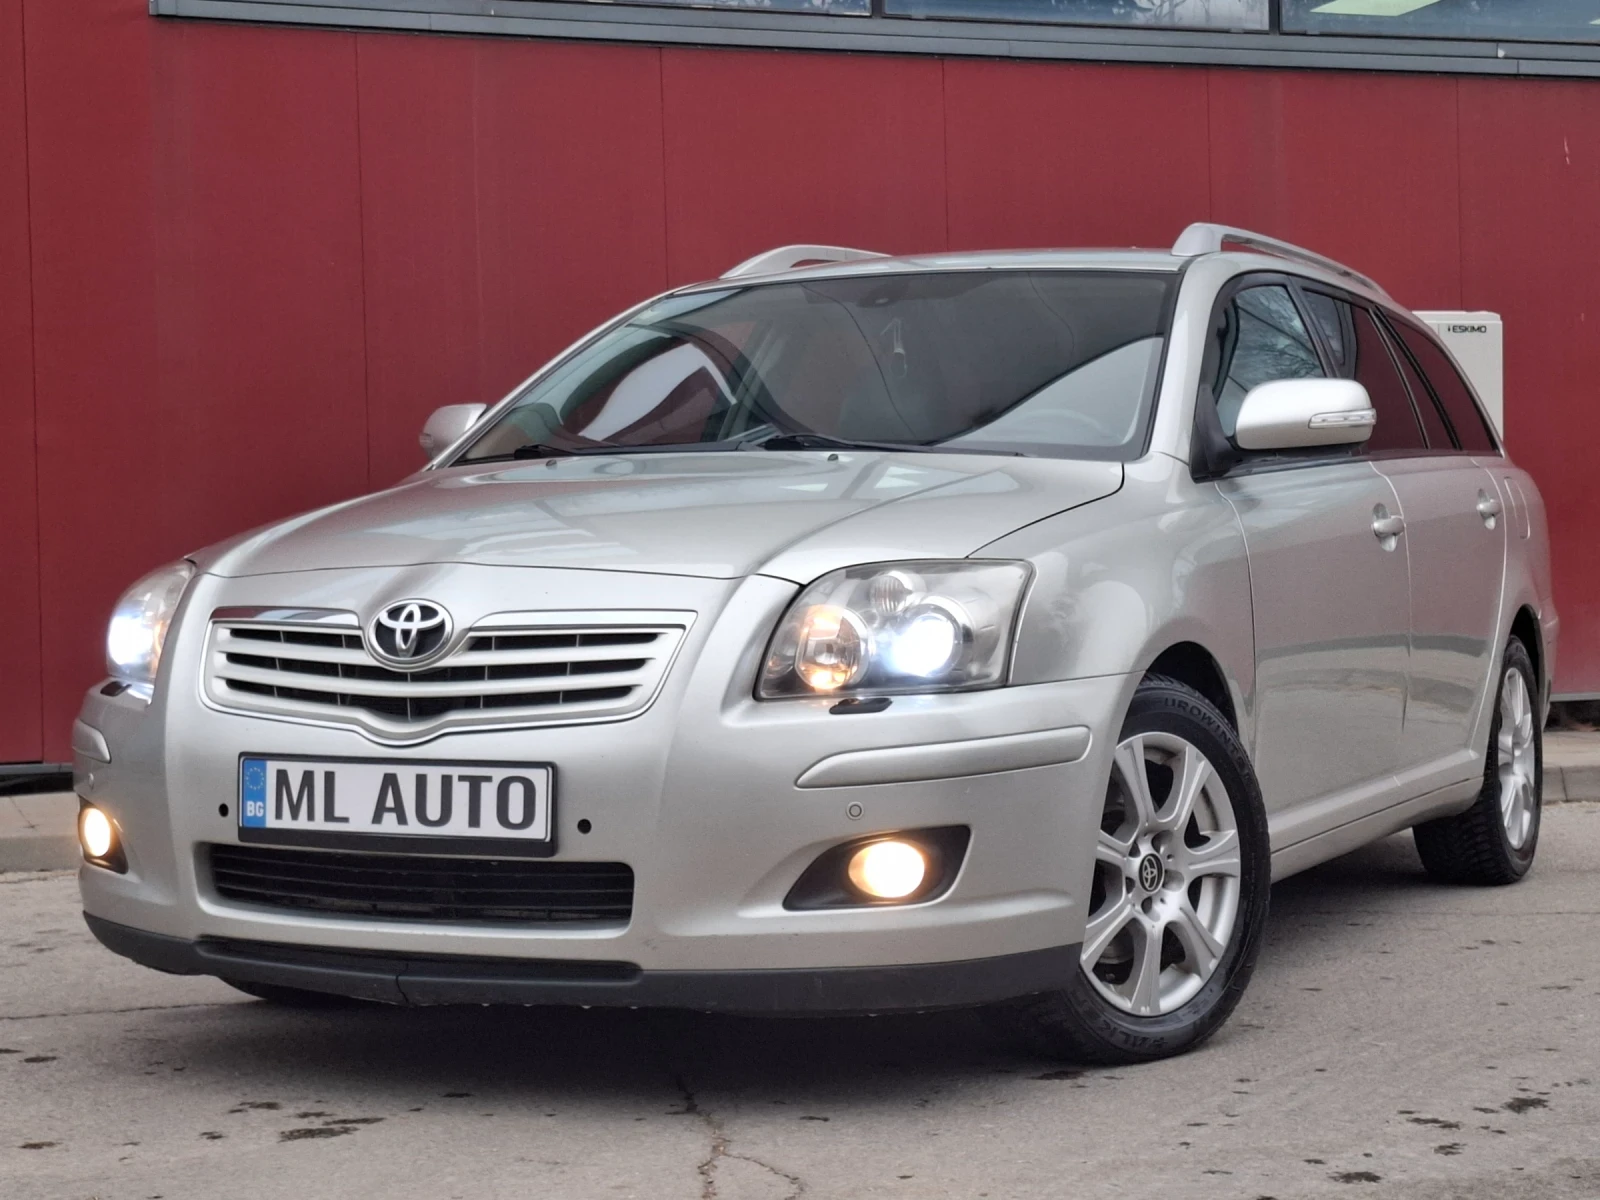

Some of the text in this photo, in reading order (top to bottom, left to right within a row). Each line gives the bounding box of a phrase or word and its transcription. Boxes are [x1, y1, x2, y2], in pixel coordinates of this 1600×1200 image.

[1452, 325, 1487, 334] ESKIMO
[274, 768, 537, 830] ML AUTO
[246, 801, 264, 817] BG
